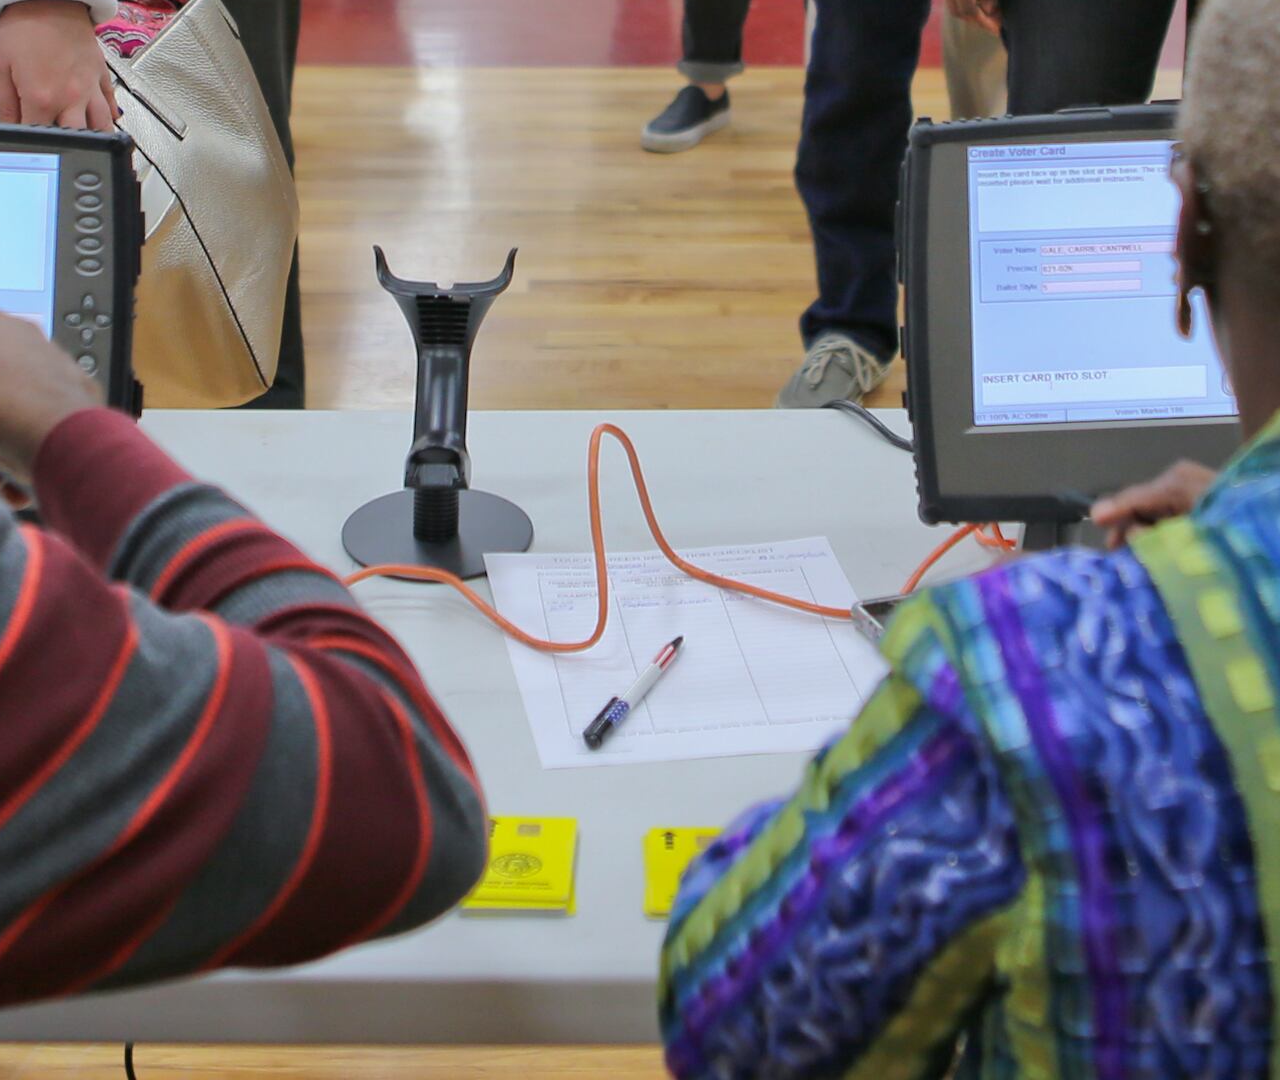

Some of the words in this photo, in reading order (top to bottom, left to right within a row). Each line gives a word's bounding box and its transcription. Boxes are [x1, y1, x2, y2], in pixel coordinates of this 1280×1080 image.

[970, 148, 1005, 159] Create
[1009, 147, 1037, 157] Voter
[1039, 146, 1066, 156] Card
[983, 375, 1021, 384] INSERT
[1023, 374, 1052, 383] CARD
[1055, 373, 1079, 382] INTO
[1081, 371, 1107, 380] SLOT
